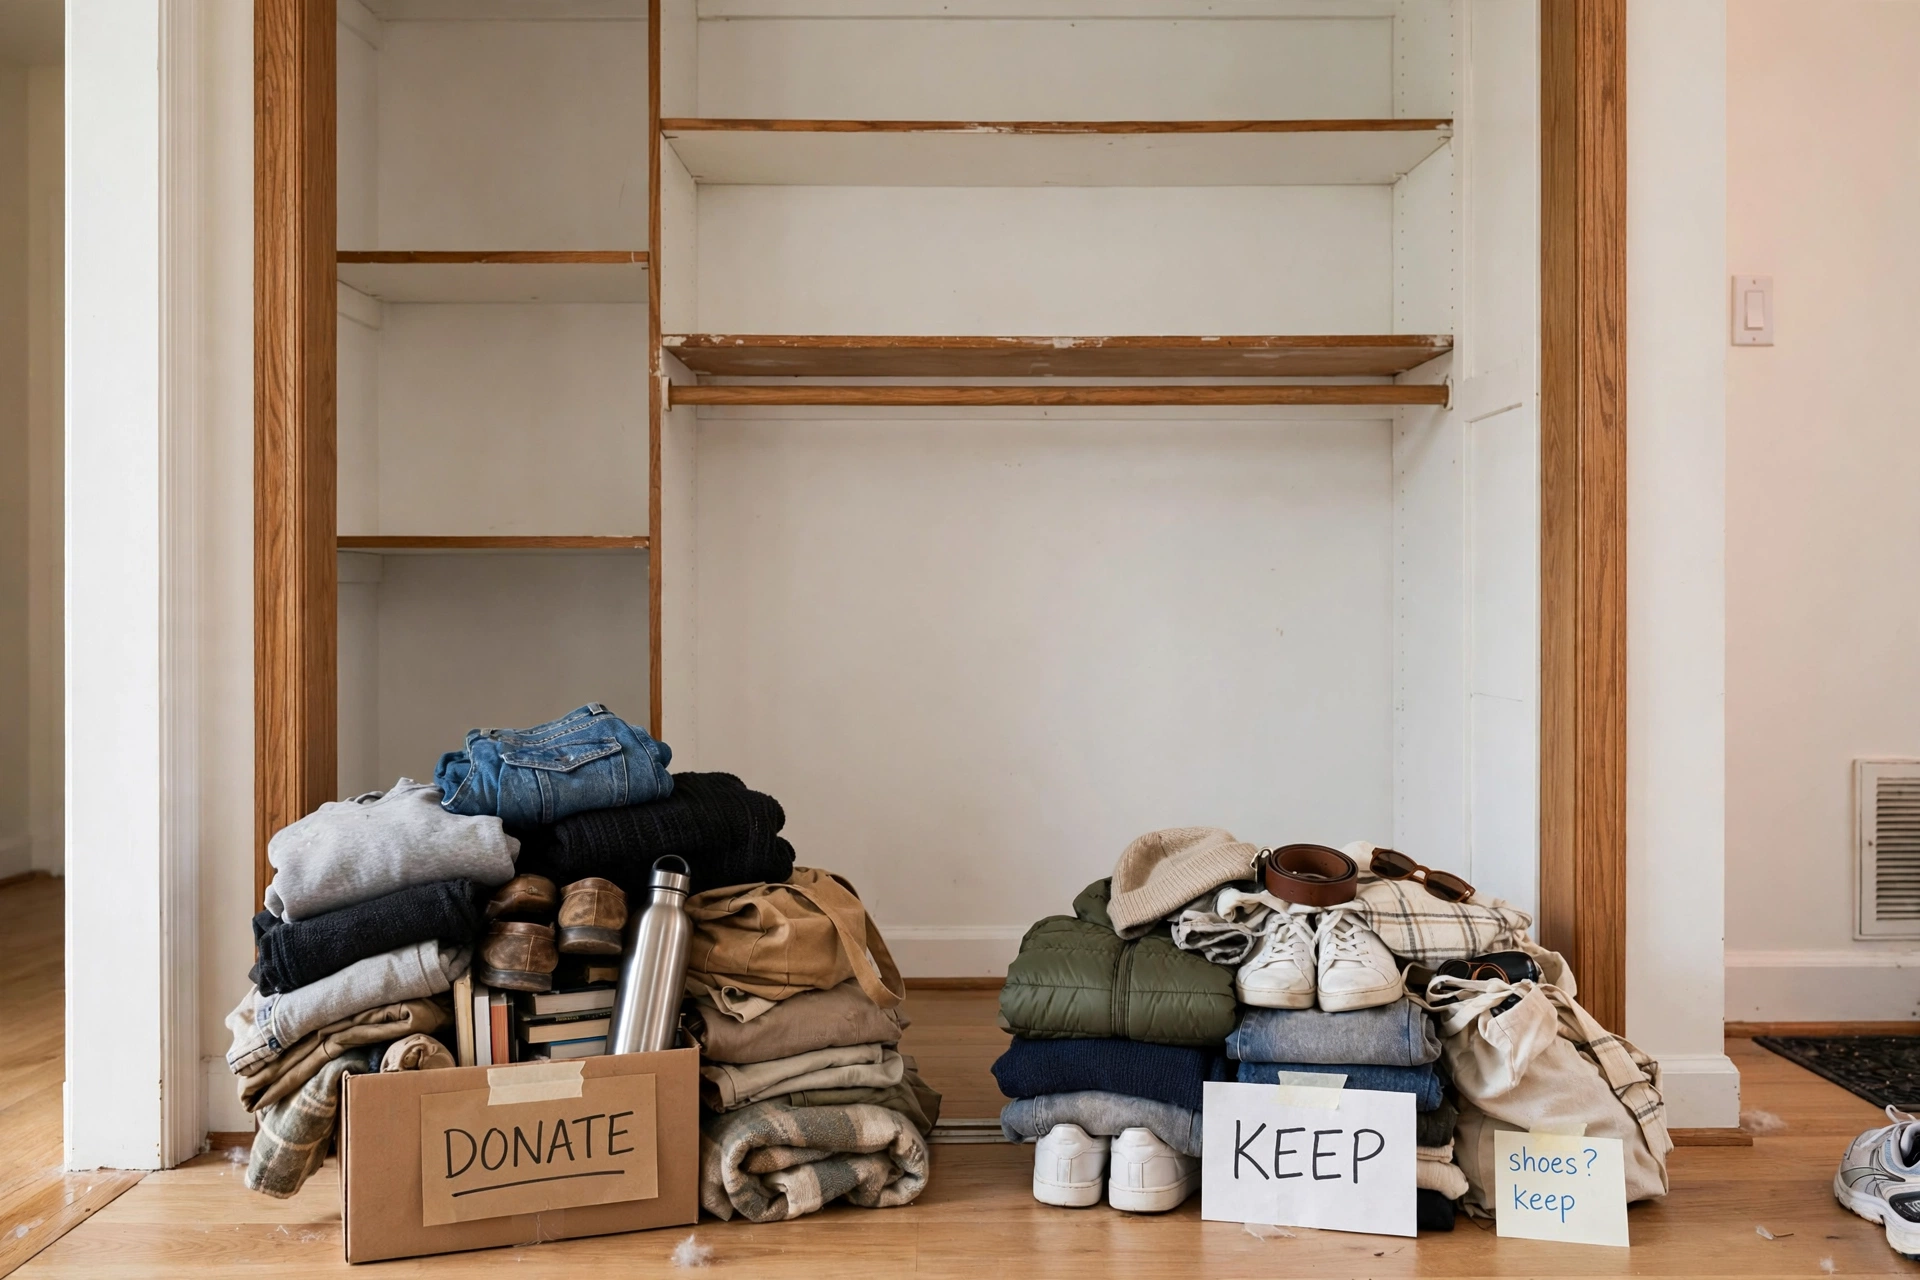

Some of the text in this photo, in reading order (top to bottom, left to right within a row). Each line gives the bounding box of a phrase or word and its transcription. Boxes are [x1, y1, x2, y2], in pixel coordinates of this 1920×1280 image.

[443, 1110, 636, 1179] DONATE
[1233, 1118, 1386, 1185] KEEP
[1508, 1146, 1599, 1178] shoes?
[1513, 1183, 1577, 1224] keep
